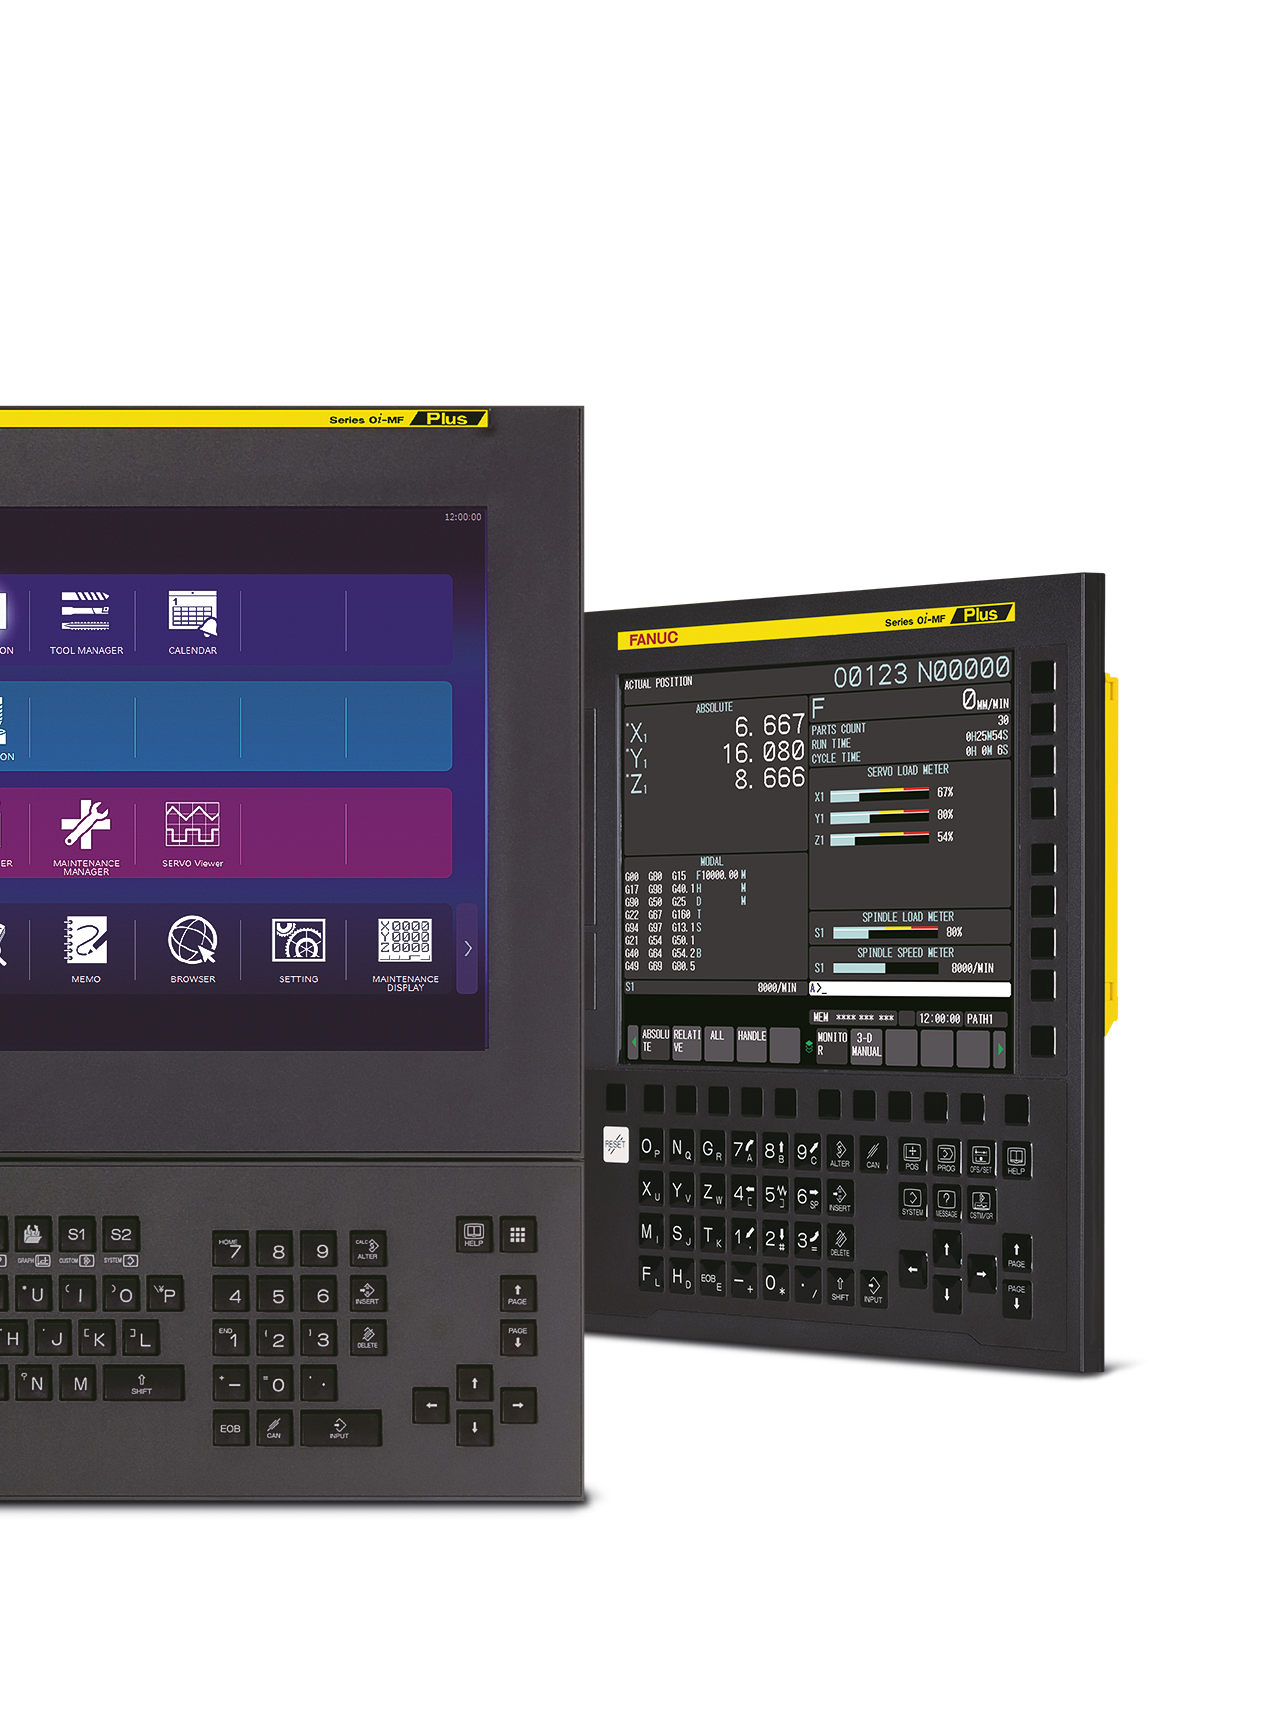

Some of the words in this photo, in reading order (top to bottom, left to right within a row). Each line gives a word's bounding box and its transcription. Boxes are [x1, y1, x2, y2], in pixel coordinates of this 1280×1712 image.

[329, 416, 365, 424] Series
[426, 412, 468, 425] Plus
[445, 513, 482, 522] 12:00:00
[885, 617, 914, 627] Series
[964, 609, 998, 622] Plus
[629, 630, 678, 646] FANUC
[50, 647, 75, 655] TOOL
[77, 647, 124, 655] MANAGER
[169, 646, 217, 655] CALENDAR
[918, 656, 1010, 683] N00000
[625, 679, 651, 690] ACTUAL
[656, 676, 693, 688] POSITION
[696, 701, 733, 714] ABSOLUTE
[977, 699, 1009, 710] MM/MIN
[812, 724, 836, 736] PARTS
[841, 723, 866, 734] COUNT
[812, 739, 828, 750] RUN
[832, 738, 851, 749] TIME
[812, 753, 836, 764] CYCLE
[842, 752, 861, 763] TIME
[868, 766, 893, 777] SERVO
[897, 765, 918, 776] LOAD
[923, 764, 949, 775] METER
[937, 787, 954, 798] 67%
[937, 831, 954, 842] 54%
[53, 859, 120, 868] MAINTENANCE
[162, 860, 192, 868] SERVO
[194, 859, 224, 868] Viewer
[700, 857, 723, 866] MODAL
[63, 868, 109, 876] MANAGER
[625, 885, 639, 894] G17
[862, 912, 898, 923] SPINDLE
[902, 912, 924, 922] LOAD
[928, 911, 954, 922] METER
[946, 927, 963, 937] 80%
[625, 936, 638, 945] G21
[857, 948, 892, 958] SPINDLE
[897, 948, 923, 958] SPEED
[928, 948, 954, 958] METER
[71, 975, 101, 983] MEMO
[171, 975, 216, 983] BROWSER
[279, 975, 319, 983] SETTING
[372, 975, 439, 983] MAINTENANCE
[387, 984, 424, 992] DISPLAY
[813, 1012, 829, 1022] MEM
[920, 1013, 960, 1024] 12:00:00
[967, 1014, 993, 1024] PATH1
[642, 1029, 670, 1039] ABSOLU
[673, 1030, 701, 1040] RELATI
[710, 1031, 724, 1041] ALL
[738, 1031, 766, 1041] HANDLE
[818, 1032, 848, 1043] MONITO
[857, 1033, 872, 1043] 3-D
[852, 1046, 882, 1057] MANUAL
[605, 1140, 625, 1149] RESET
[830, 1160, 850, 1168] ALTER
[866, 1161, 880, 1169] CAN
[1008, 1167, 1025, 1175] HELP
[68, 1229, 85, 1241] S1
[111, 1229, 131, 1241] S2
[1008, 1260, 1025, 1268] PAGE
[831, 1293, 849, 1301] SHIFT
[220, 1424, 240, 1433] EOB
